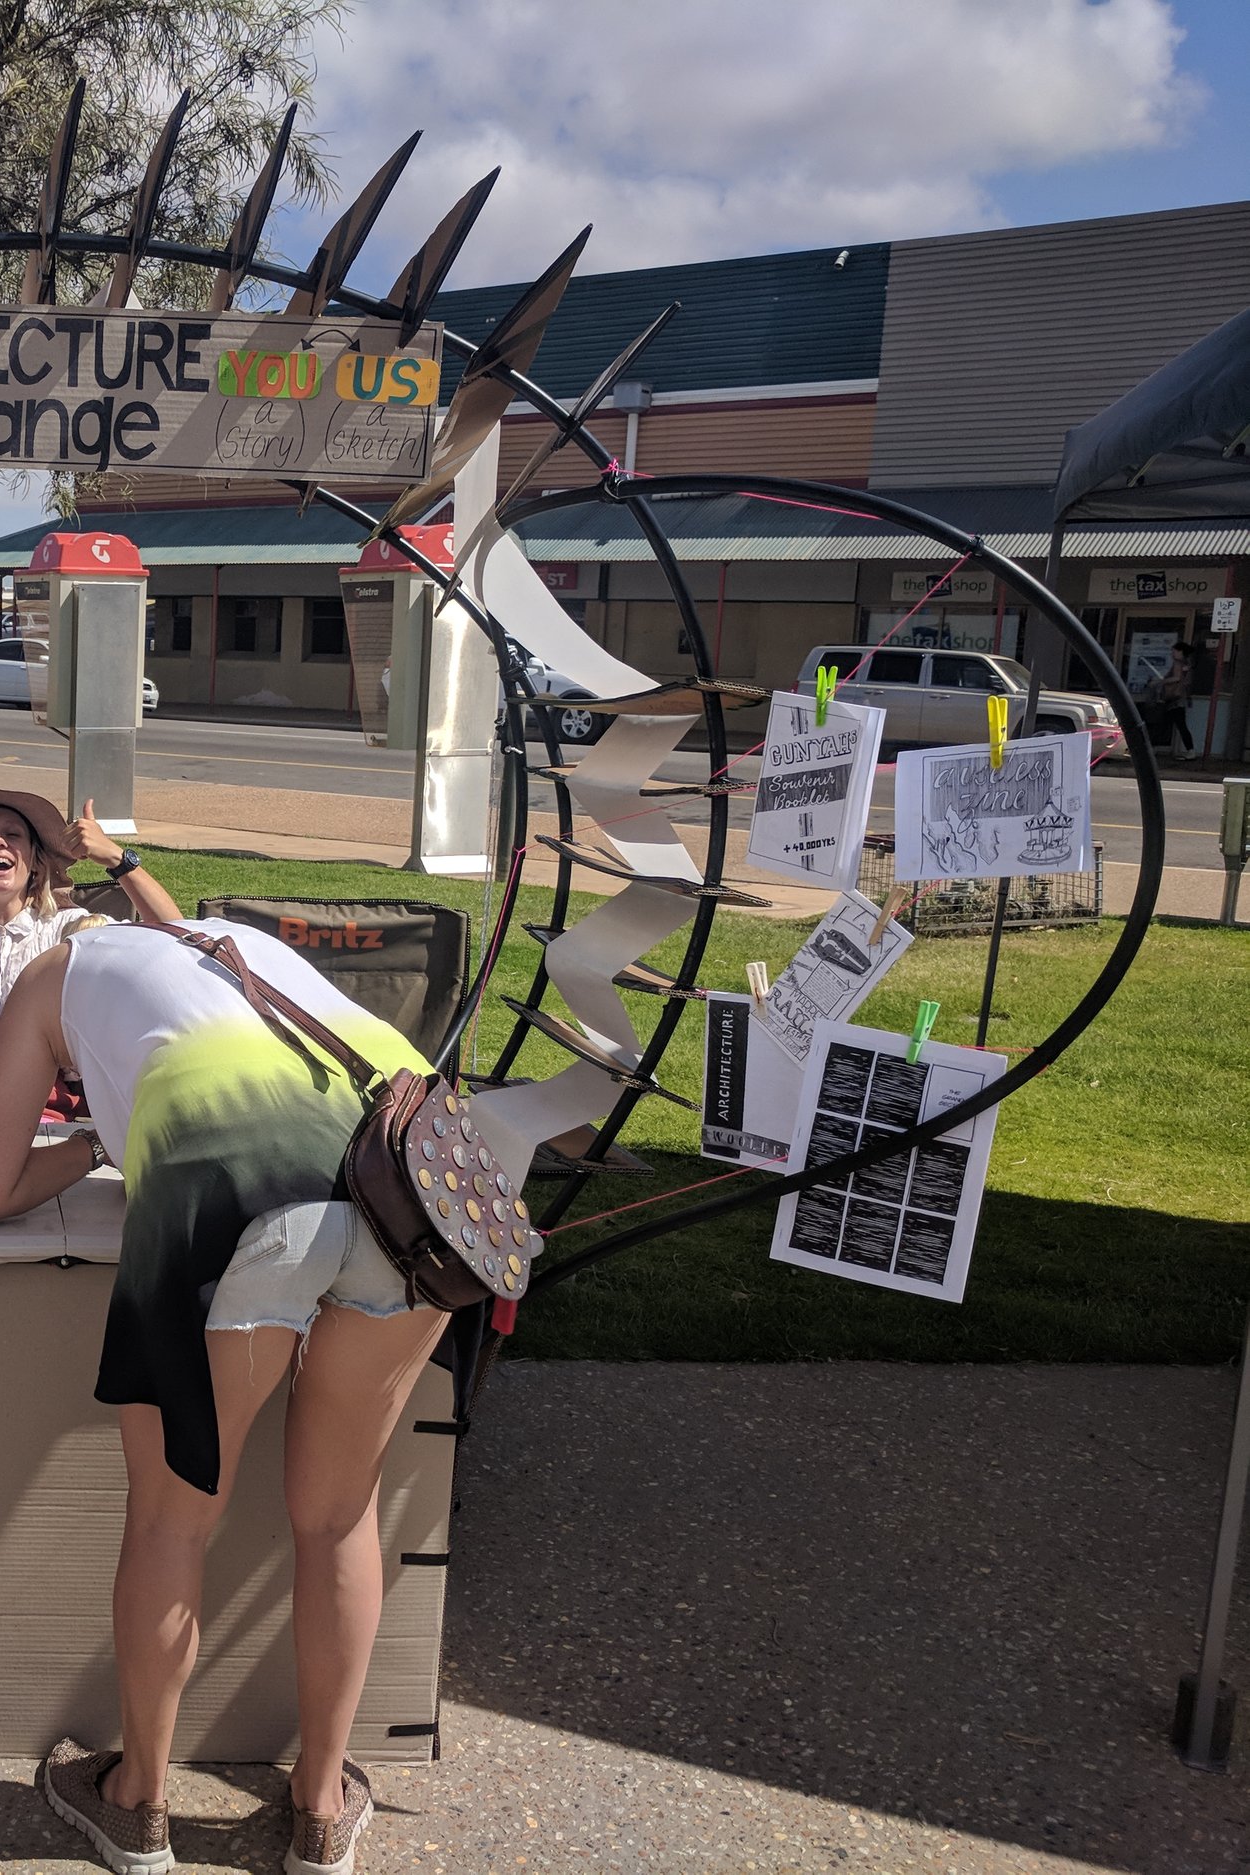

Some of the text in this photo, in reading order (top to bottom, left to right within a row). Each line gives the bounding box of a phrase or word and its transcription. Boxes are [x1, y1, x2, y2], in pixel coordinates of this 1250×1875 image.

[227, 350, 318, 400] YOU
[352, 356, 422, 405] US
[903, 578, 925, 592] the
[953, 578, 988, 594] shop
[1110, 577, 1208, 594] the tax shop
[769, 771, 836, 792] Souvenir
[773, 788, 830, 811] Booklet
[278, 916, 384, 949] Britz
[717, 1008, 735, 1121] ARCHITECTURE
